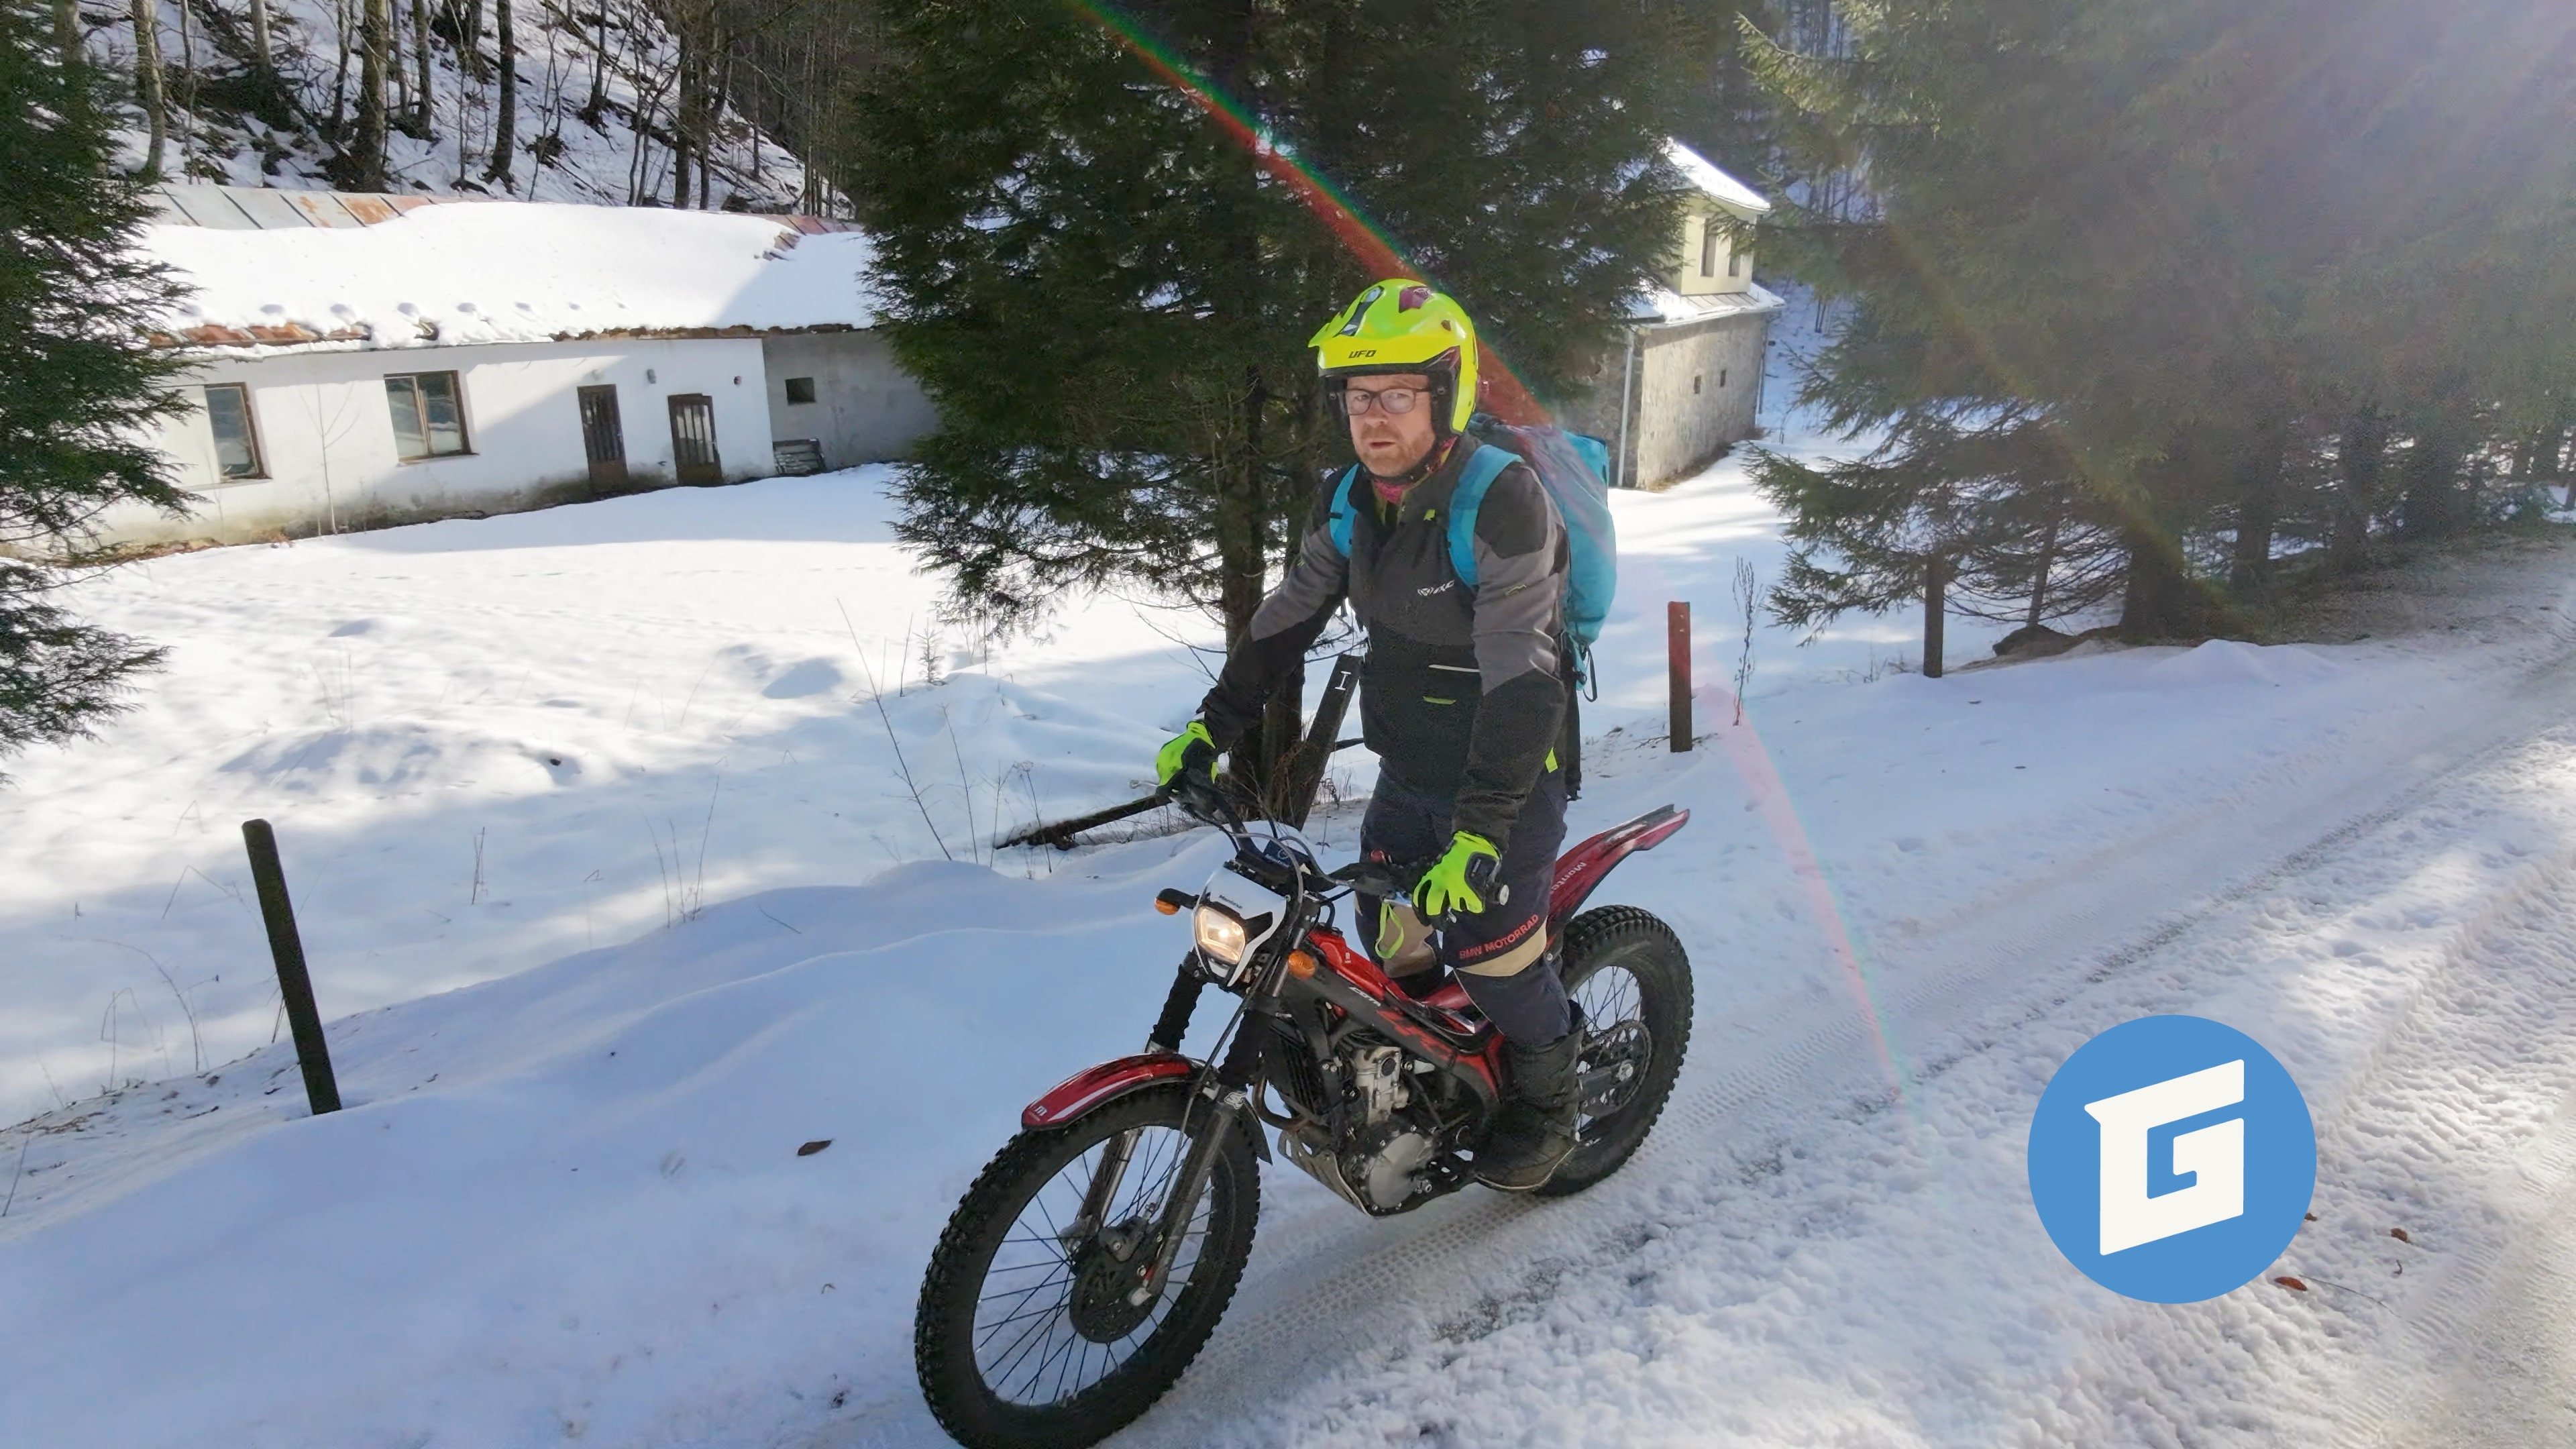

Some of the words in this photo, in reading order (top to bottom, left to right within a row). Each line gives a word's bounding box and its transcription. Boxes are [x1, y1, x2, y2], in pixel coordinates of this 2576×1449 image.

[1348, 350, 1377, 358] UFO
[1550, 862, 1587, 895] Monte
[1459, 945, 1482, 959] BMW
[1485, 914, 1539, 952] MOTORRAD
